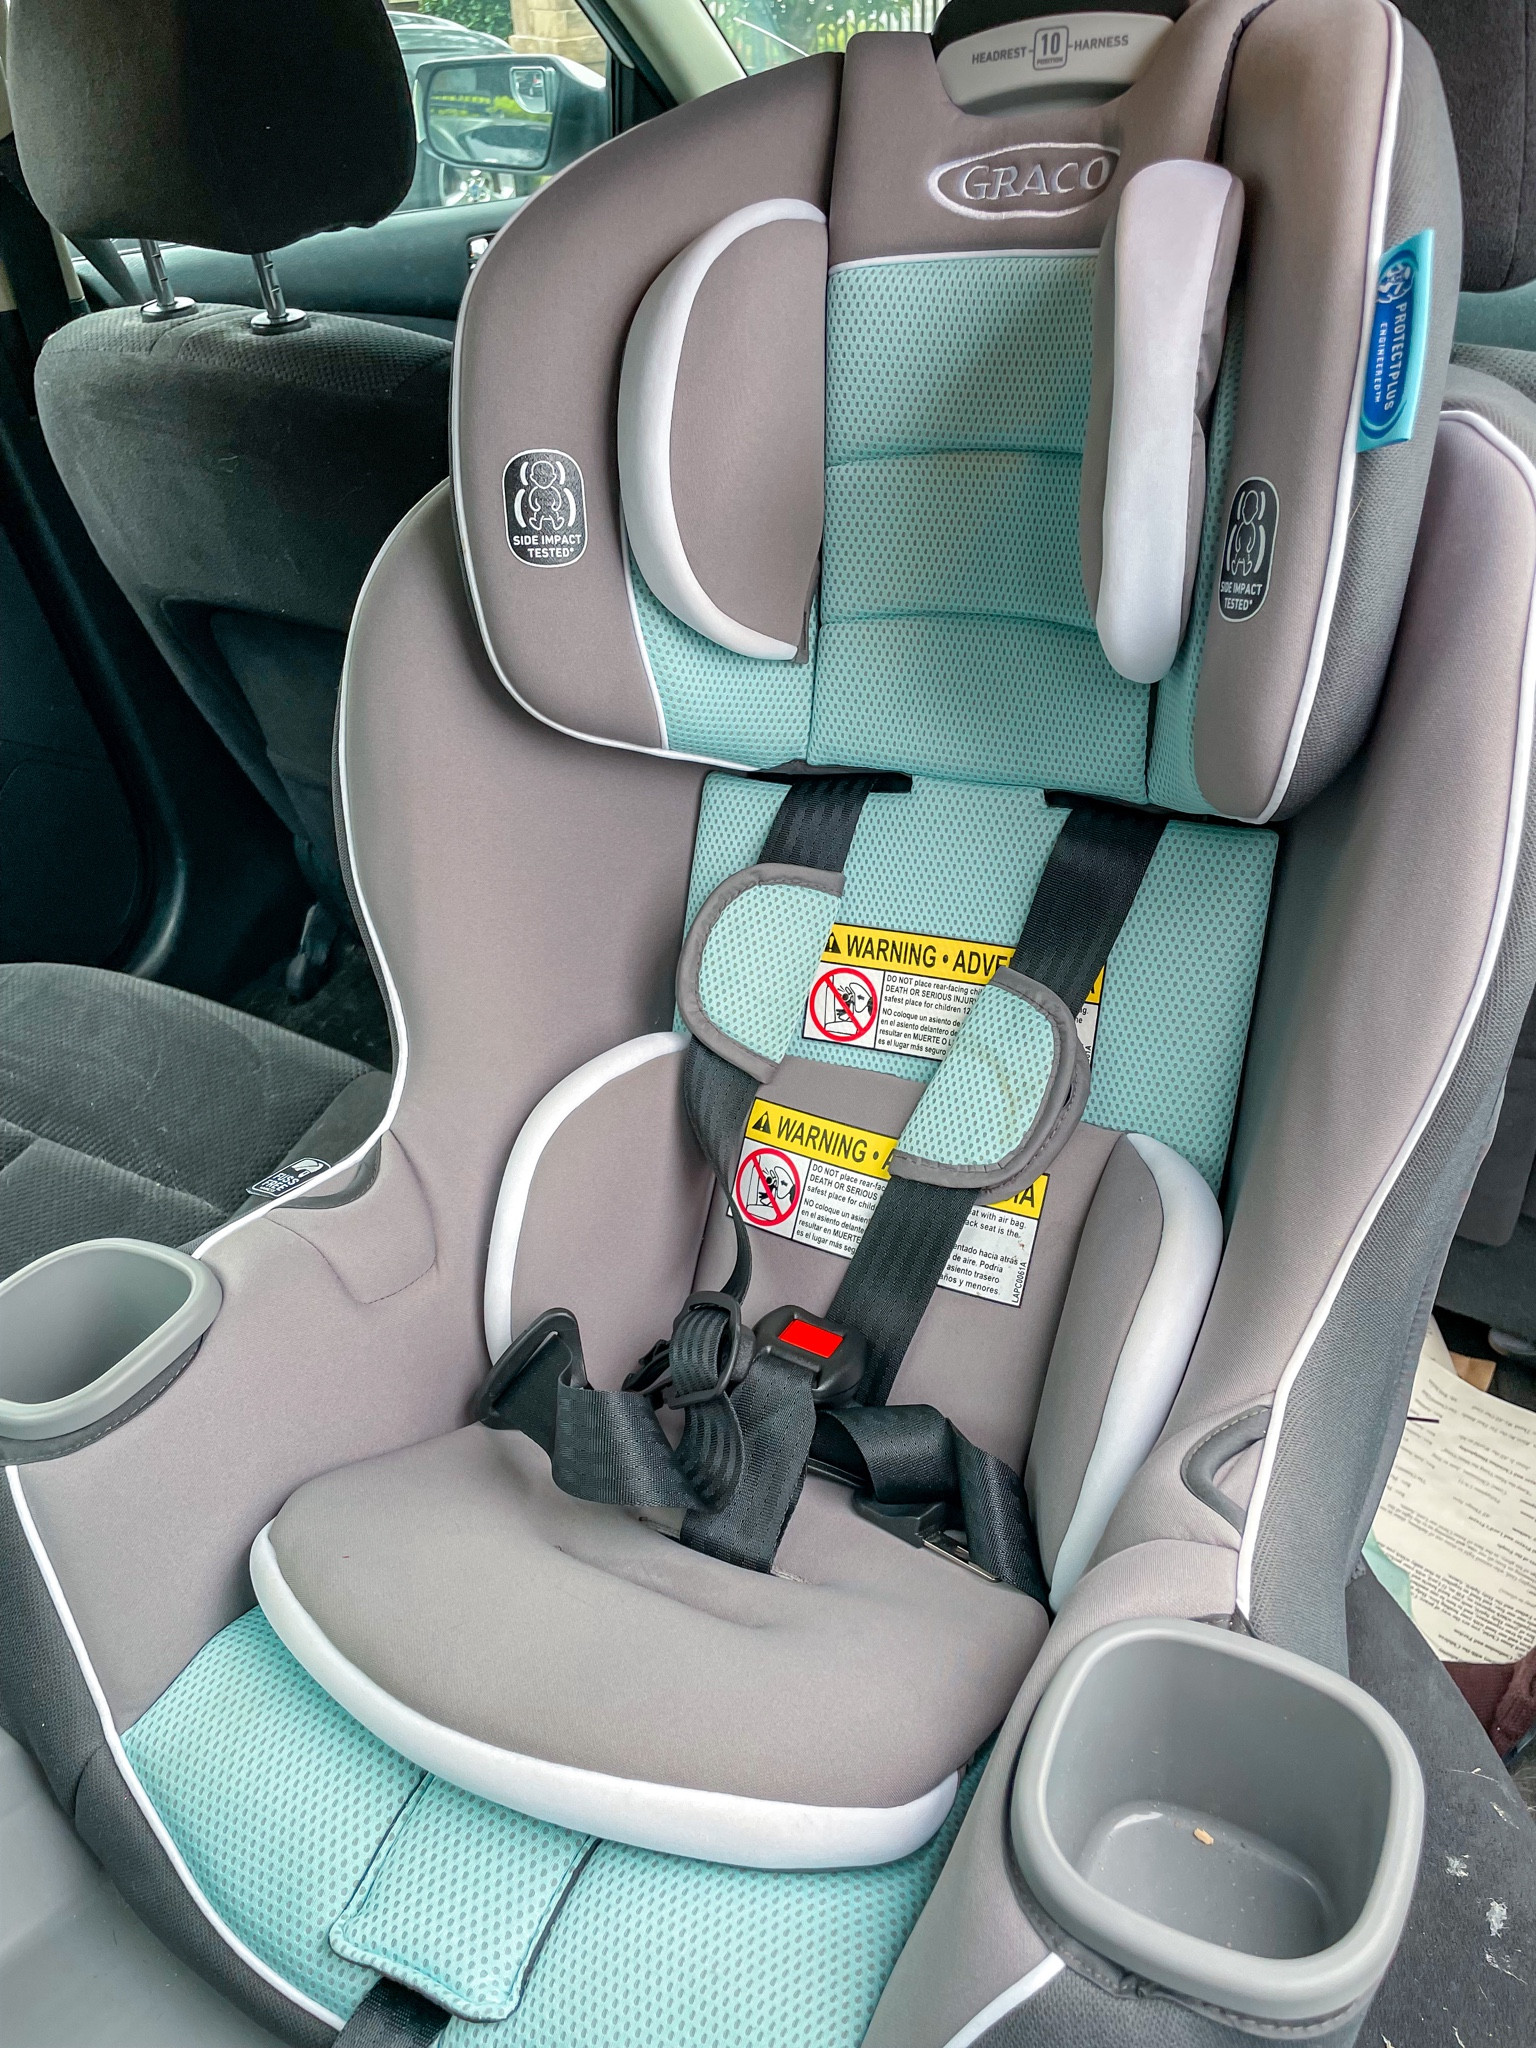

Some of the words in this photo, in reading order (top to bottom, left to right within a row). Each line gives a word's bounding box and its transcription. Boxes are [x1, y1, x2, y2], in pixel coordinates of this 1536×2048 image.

[1041, 32, 1061, 56] 10
[1074, 34, 1129, 51] HARNESS
[972, 46, 1027, 65] HEADREST
[959, 156, 1110, 200] GRACO
[1384, 301, 1408, 411] PROTECTPLUS
[513, 535, 539, 546] SIDE
[541, 534, 582, 545] IMPACT
[1233, 582, 1263, 595] IMPACT
[846, 934, 937, 968] WARNING
[952, 949, 1010, 977] ADVE
[885, 984, 908, 995] DEATH
[909, 988, 920, 997] OR
[921, 990, 952, 1001] SERIOUS
[886, 974, 898, 983] DO
[899, 976, 914, 985] NOT
[914, 978, 932, 988] place
[933, 982, 969, 995] rear-facing
[884, 995, 904, 1004] safest
[905, 997, 922, 1008] place
[923, 1000, 933, 1009] for
[934, 1002, 961, 1013] children
[963, 1007, 972, 1015] 12
[880, 1018, 888, 1026] en
[896, 1020, 919, 1031] asiento
[920, 1023, 949, 1036] delantero
[882, 1007, 893, 1016] NO
[893, 1010, 918, 1021] coloque
[919, 1014, 928, 1022] un
[928, 1016, 952, 1026] asiento
[879, 1028, 903, 1037] resultar
[913, 1033, 941, 1045] MUERTE
[941, 1037, 947, 1045] O
[886, 1038, 893, 1046] el
[893, 1040, 909, 1050] lugar
[910, 1043, 923, 1052] más
[924, 1046, 947, 1056] seguro
[777, 1115, 868, 1163] WARNING
[261, 1179, 288, 1192] FREE
[807, 1185, 827, 1196] safest
[828, 1191, 846, 1203] place
[847, 1195, 858, 1206] for
[812, 1163, 823, 1173] DO
[824, 1167, 839, 1178] NOT
[840, 1172, 858, 1183] place
[980, 1211, 996, 1221] with
[998, 1215, 1008, 1223] air
[809, 1173, 833, 1187] DEATH
[834, 1181, 845, 1191] OR
[846, 1184, 878, 1201] SERIOUS
[965, 1219, 978, 1228] ack
[980, 1222, 996, 1232] seat
[998, 1226, 1005, 1235] is
[801, 1209, 809, 1217] en
[810, 1211, 816, 1219] el
[816, 1213, 840, 1227] asiento
[952, 1253, 962, 1262] de
[803, 1198, 814, 1208] NO
[814, 1201, 840, 1216] coloque
[841, 1209, 850, 1219] un
[979, 1247, 999, 1260] hacia
[796, 1229, 804, 1237] es
[804, 1231, 811, 1239] el
[811, 1232, 828, 1245] lugar
[828, 1239, 843, 1250] más
[958, 1279, 964, 1287] y
[798, 1219, 823, 1231] resultar
[823, 1226, 832, 1235] en
[832, 1229, 862, 1245] MUERTE
[946, 1263, 973, 1277] asiento
[973, 1269, 1000, 1284] trasero
[1011, 1261, 1027, 1304] LAPC0061A
